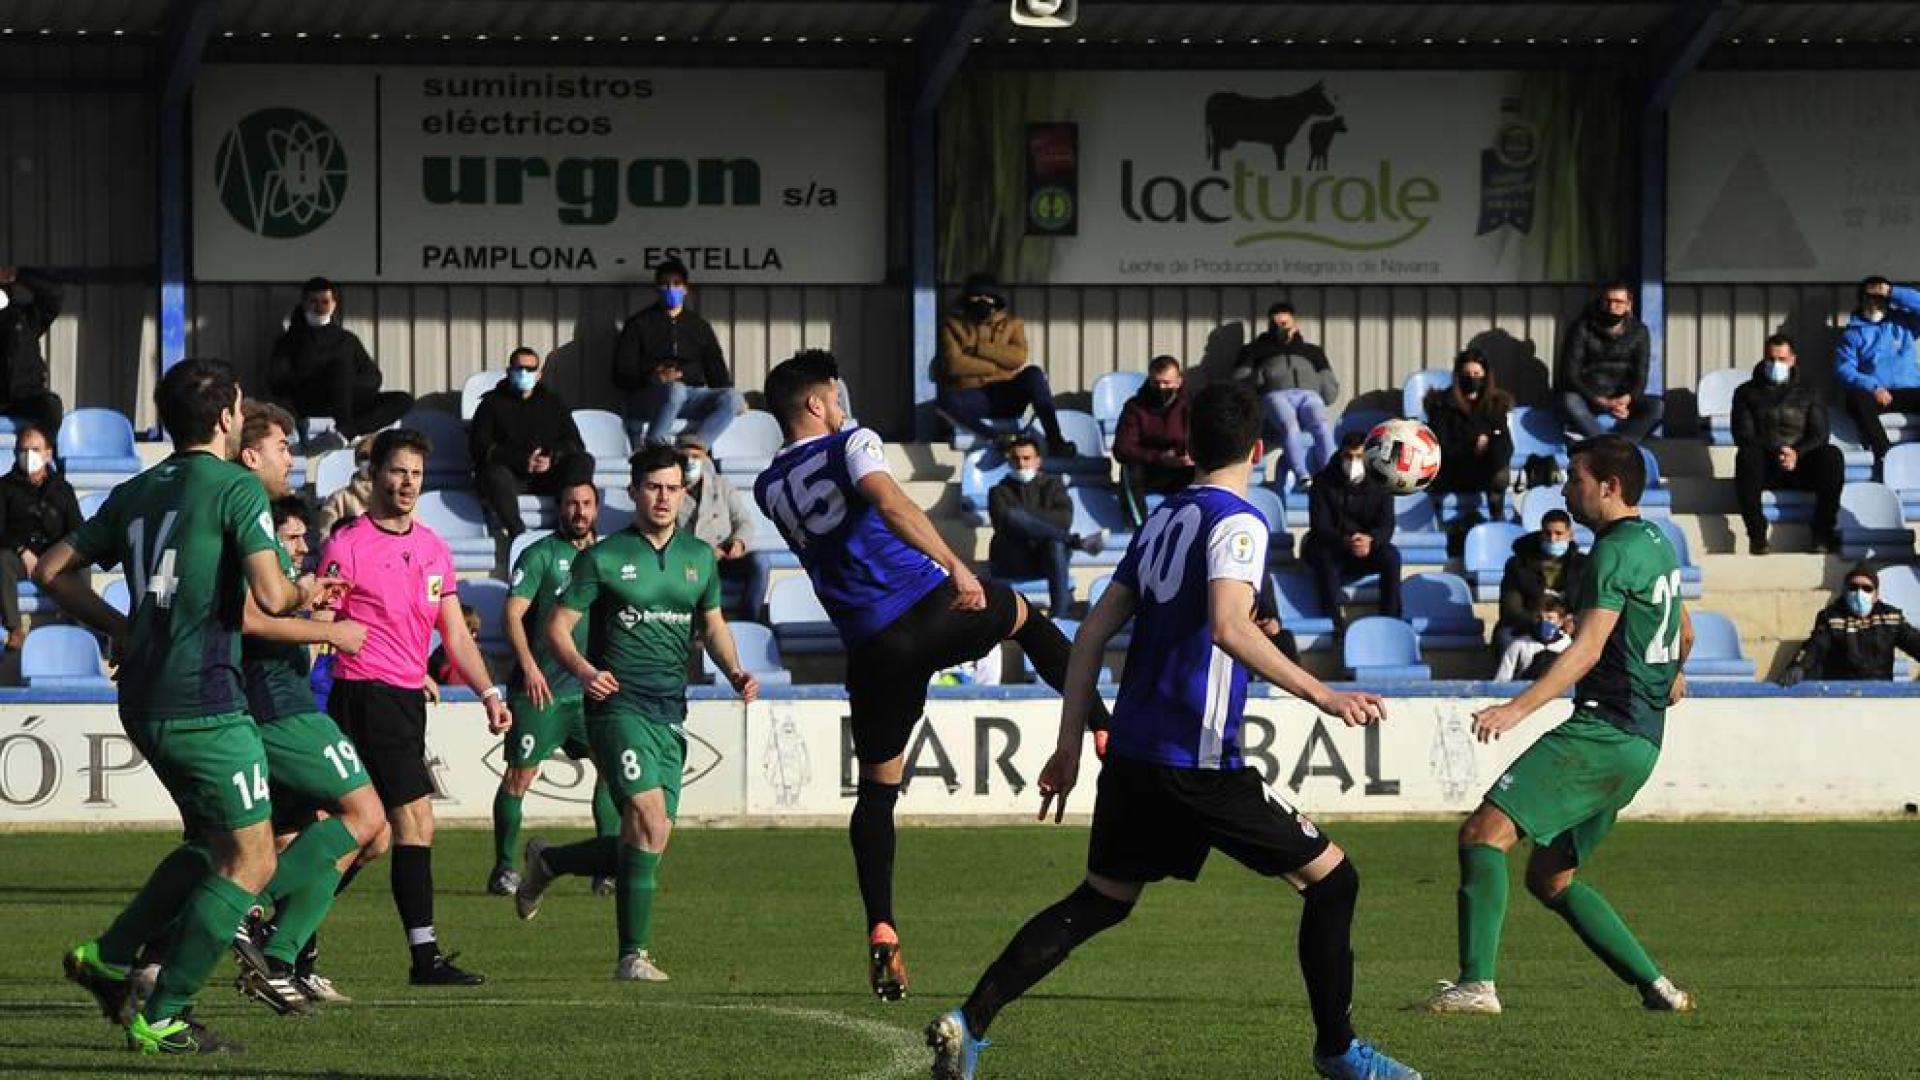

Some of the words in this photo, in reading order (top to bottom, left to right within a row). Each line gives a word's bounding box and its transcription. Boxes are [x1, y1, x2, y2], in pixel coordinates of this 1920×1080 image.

[422, 73, 654, 99] suministros
[421, 110, 613, 136] eléctricos
[422, 155, 761, 226] urgon
[783, 181, 838, 206] s/a
[1120, 159, 1440, 226] lacturale
[422, 246, 599, 270] PAMPLONA
[643, 246, 782, 270] ESTELLA
[1119, 257, 1165, 274] Leche
[1168, 257, 1190, 274] de
[1193, 256, 1278, 274] Producción
[1281, 257, 1353, 277] Integrada
[1356, 257, 1377, 274] de
[1380, 257, 1440, 274] Navarra
[765, 449, 847, 536] 15
[127, 510, 180, 609] 14
[1137, 503, 1202, 604] 10
[323, 739, 361, 779] 19
[519, 733, 536, 759] 9
[619, 749, 642, 781] 8
[232, 762, 270, 811] 14
